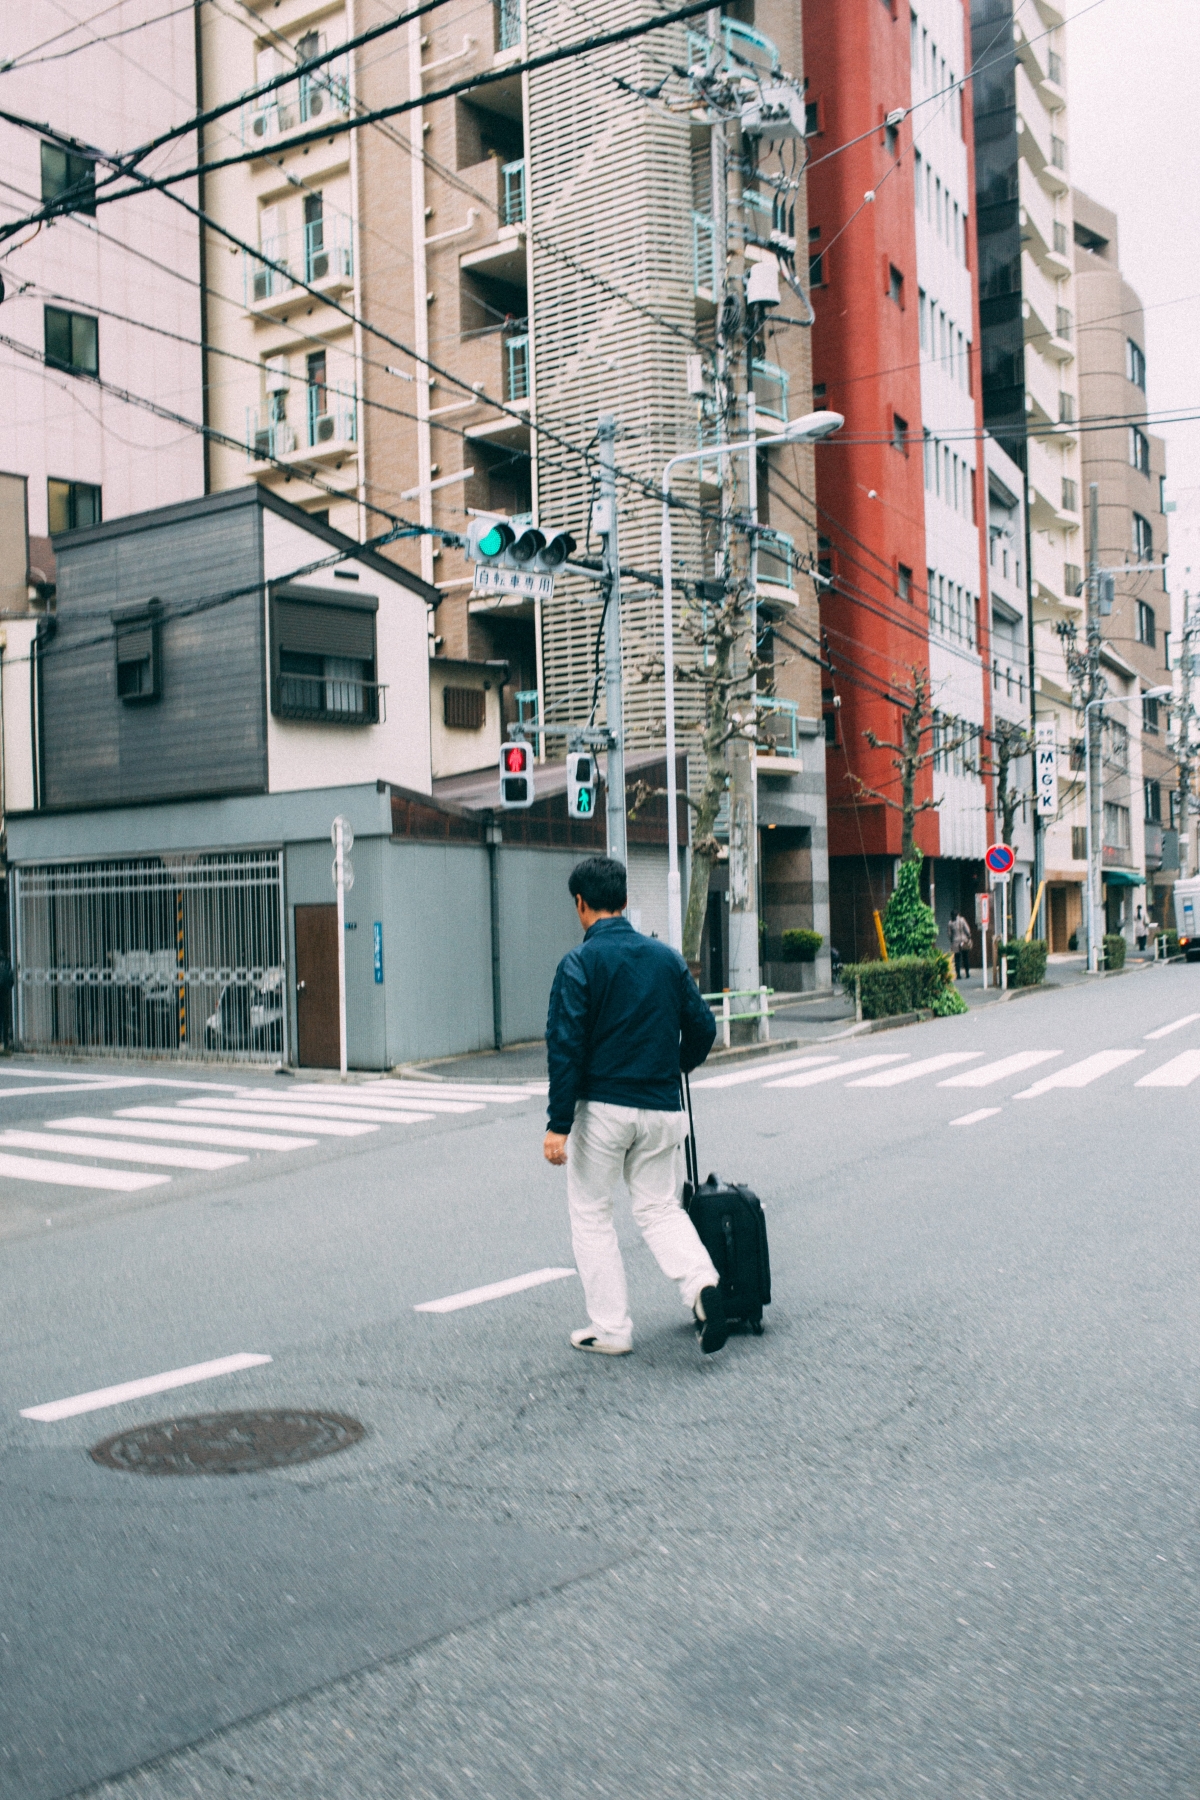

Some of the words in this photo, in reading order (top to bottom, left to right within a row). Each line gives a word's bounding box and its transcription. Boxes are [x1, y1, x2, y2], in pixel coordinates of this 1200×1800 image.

[480, 569, 551, 593] 自転車専用
